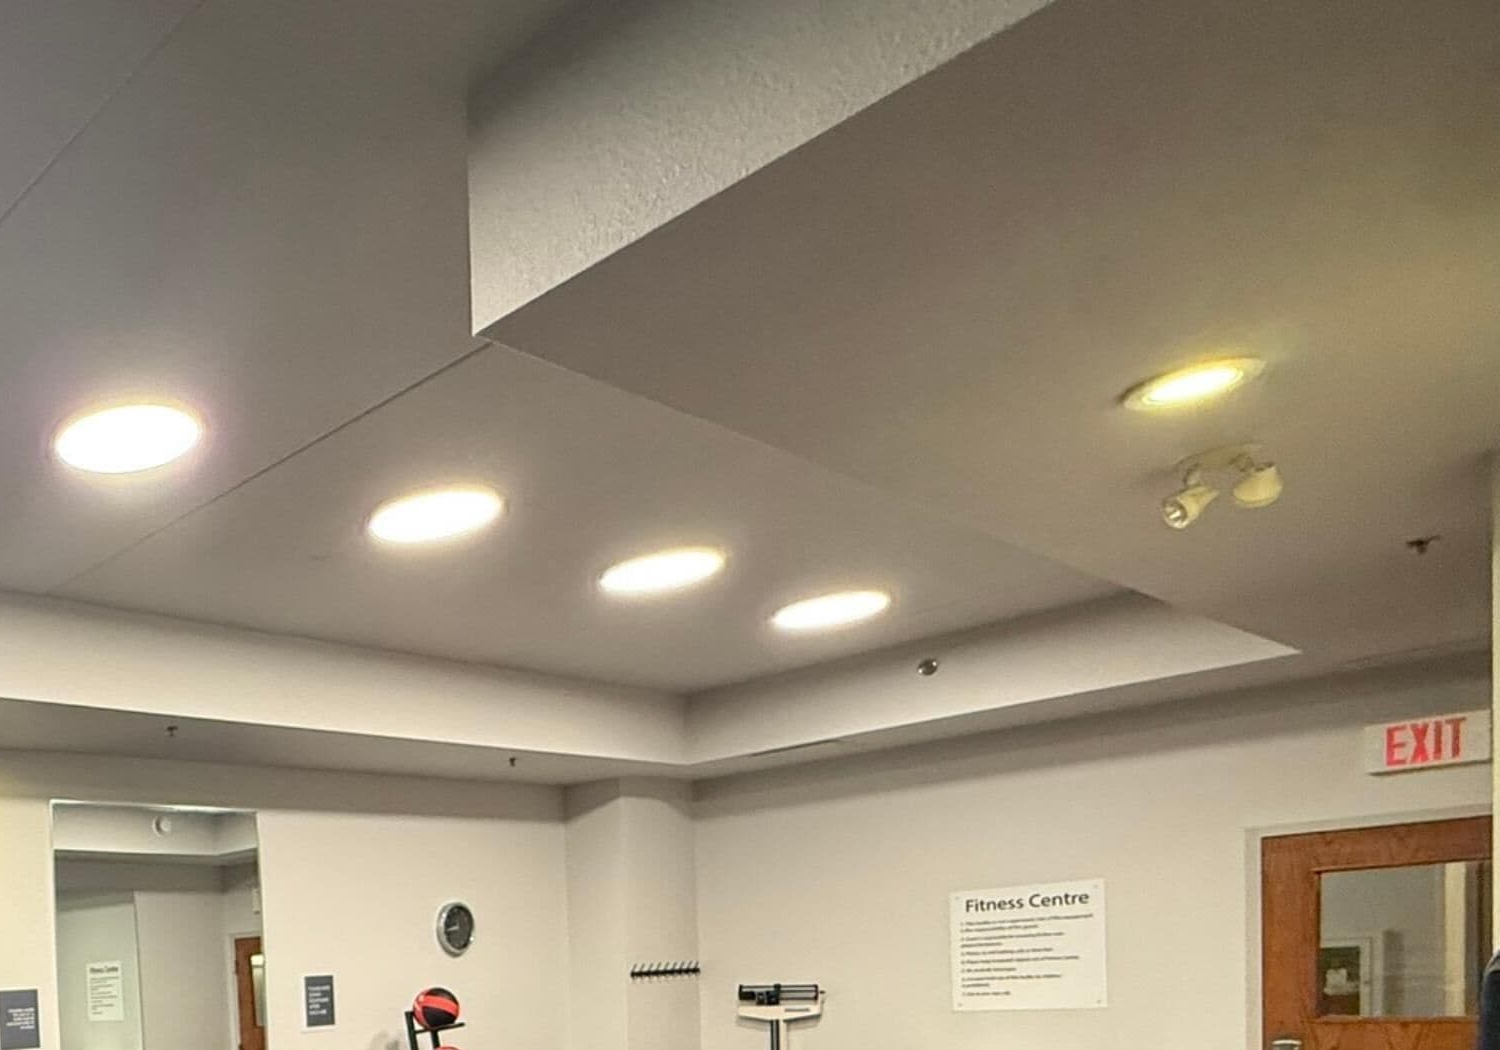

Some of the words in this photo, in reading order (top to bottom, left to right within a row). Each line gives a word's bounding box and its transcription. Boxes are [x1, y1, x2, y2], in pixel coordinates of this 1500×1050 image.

[1386, 716, 1467, 767] EXIT
[965, 897, 1025, 913] Fitness
[1029, 892, 1090, 908] Centre
